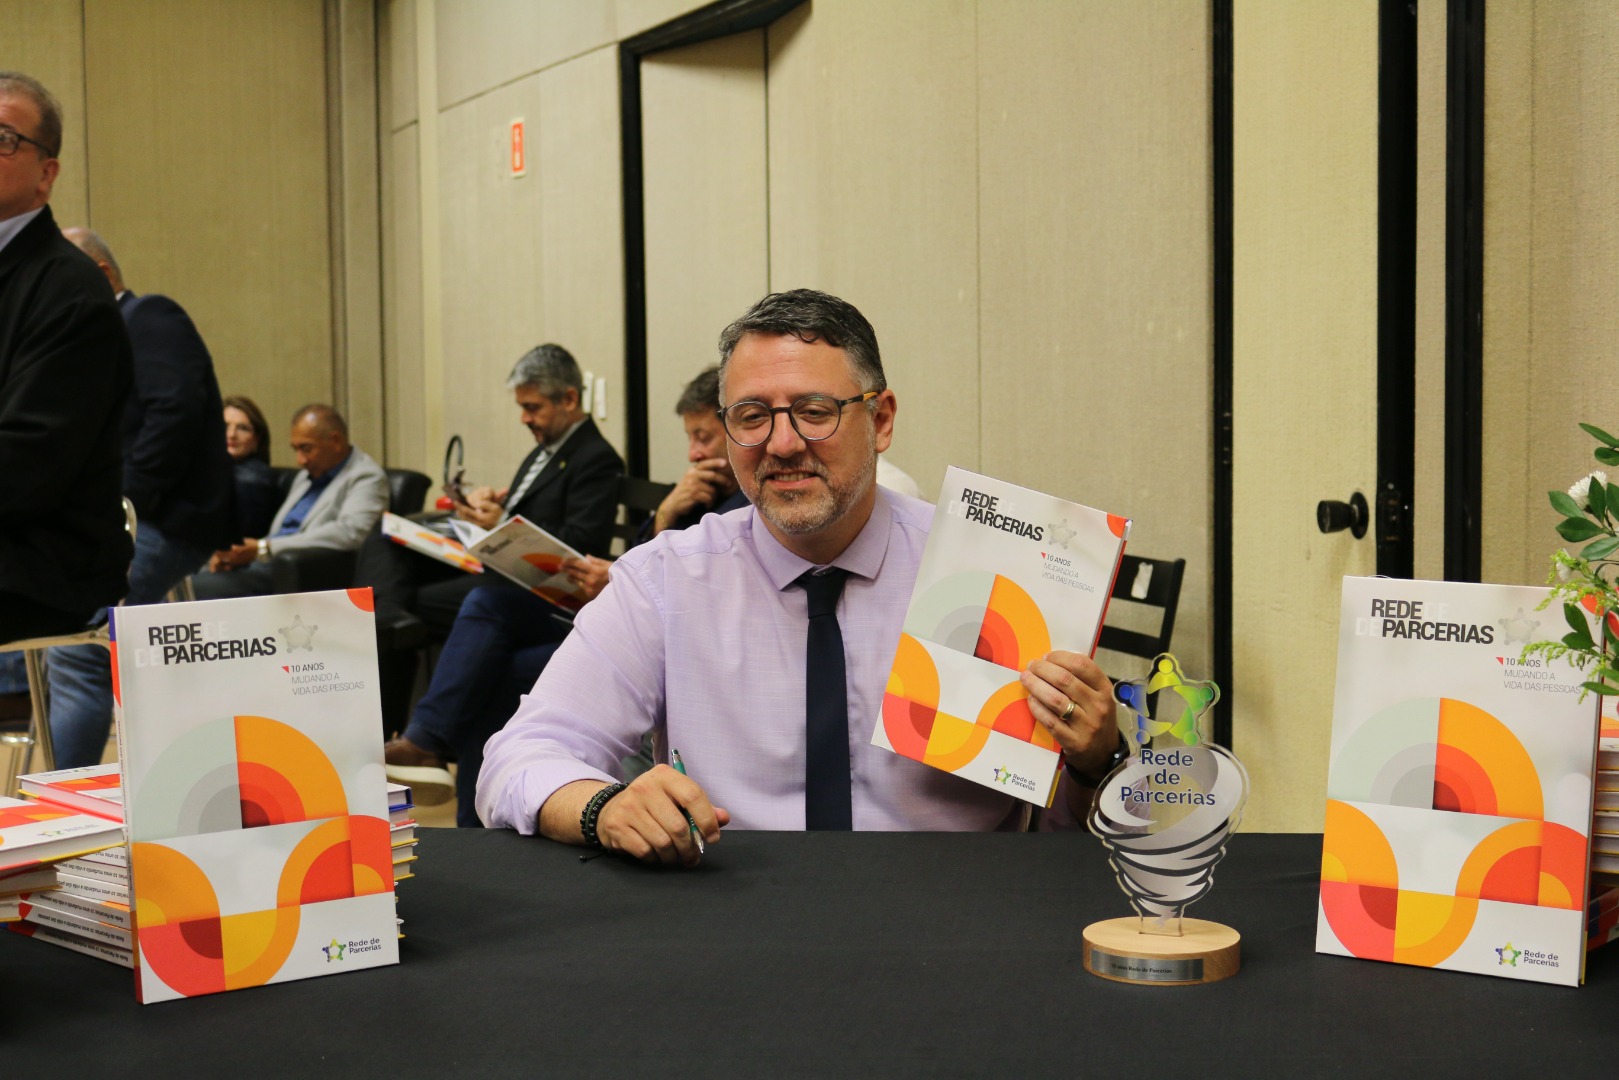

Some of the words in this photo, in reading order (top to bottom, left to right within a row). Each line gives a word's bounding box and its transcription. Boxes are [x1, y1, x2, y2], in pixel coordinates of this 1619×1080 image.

[961, 488, 999, 512] REDE
[965, 505, 1044, 542] PARCERIAS
[1054, 557, 1072, 567] ANOS
[1043, 563, 1075, 578] MUDANDO
[1041, 571, 1055, 581] VIDA
[1055, 575, 1069, 585] DAS
[1068, 580, 1095, 594] PESSOAS
[1371, 598, 1424, 620] REDE
[149, 623, 203, 646] REDE
[1382, 618, 1495, 645] PARCERIAS
[163, 637, 277, 665] PARCERIAS
[291, 665, 301, 673] 10
[302, 662, 325, 672] ANOS
[1505, 657, 1516, 666] 10
[291, 673, 333, 684] MUDANDO
[1504, 669, 1548, 680] MUDANDO
[1549, 672, 1556, 681] A
[292, 687, 311, 696] VIDA
[312, 684, 329, 694] DAS
[329, 681, 365, 692] PESSOAS
[1503, 680, 1523, 690] VIDA
[1524, 681, 1542, 692] DAS
[1542, 683, 1582, 694] PESSOAS
[1140, 749, 1194, 766] Rede
[1012, 773, 1028, 784] Rede
[1154, 768, 1181, 785] de
[1120, 786, 1216, 806] Parcerias
[348, 939, 368, 948] Rede
[349, 944, 382, 954] Parcerias
[1523, 957, 1559, 967] Parcerias
[1524, 950, 1546, 959] Rede
